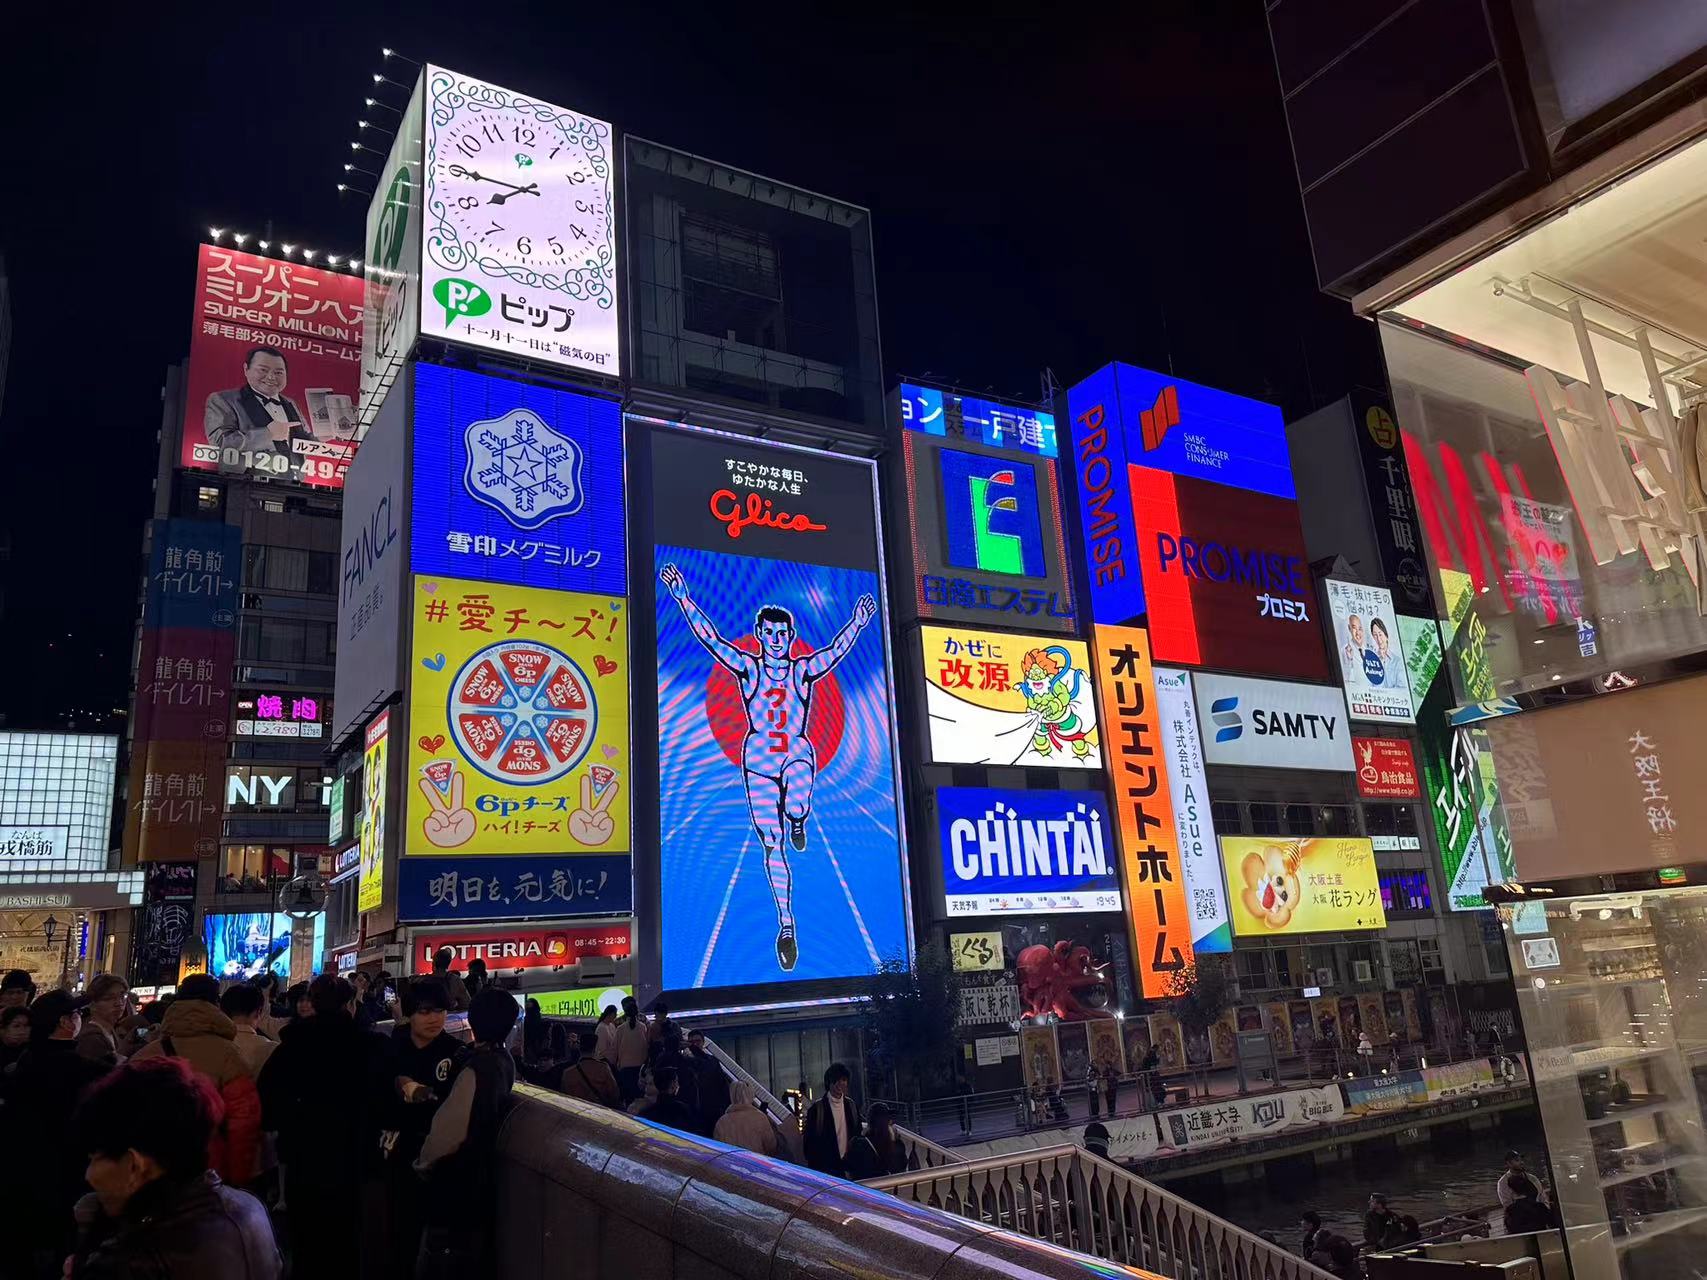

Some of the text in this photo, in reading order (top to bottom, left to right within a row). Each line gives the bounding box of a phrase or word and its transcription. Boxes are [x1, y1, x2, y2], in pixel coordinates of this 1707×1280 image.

[482, 124, 505, 144] 11
[511, 126, 537, 148] 12
[456, 134, 482, 159] 10
[548, 146, 562, 160] 1
[448, 164, 470, 180] 9
[565, 171, 586, 186] 2
[458, 196, 479, 210] 8
[574, 199, 594, 215] 3
[484, 221, 505, 237] 7
[569, 222, 588, 241] 4
[516, 236, 532, 255] 6
[546, 236, 564, 255] 5
[206, 251, 319, 288] スーパー
[204, 301, 272, 324] SUPER
[278, 316, 348, 341] MILLION
[500, 293, 575, 333] ピップ
[1184, 432, 1206, 446] SMBC
[1372, 409, 1395, 445] 占
[1185, 442, 1230, 461] CONSUMER
[1187, 453, 1223, 469] FINANCE
[725, 458, 809, 483] すこやかな毎日、
[732, 473, 801, 495] ゆたかな人生
[1077, 404, 1126, 587] PROMISE
[710, 489, 827, 538] Glico
[342, 485, 397, 608] FANCL
[446, 530, 602, 568] 雪印メグミルク
[165, 547, 225, 572] 龍角散
[1157, 532, 1305, 595] PROMISE
[154, 571, 221, 595] ダイレクト
[1256, 592, 1310, 622] プロミス
[509, 653, 543, 664] SNOW
[944, 637, 1002, 658] かぜに
[155, 657, 214, 681] 龍角散
[464, 665, 489, 697] SNOW
[938, 658, 1011, 692] 改源
[1158, 674, 1180, 687] Asue
[144, 682, 211, 705] ダイレクト
[560, 673, 583, 703] SNOW
[763, 684, 789, 753] グリコ
[1252, 709, 1336, 740] SAMTY
[464, 721, 487, 752] SNOW
[561, 725, 582, 757] SNOW
[506, 760, 541, 771] SNOW
[144, 773, 207, 797] 龍角散
[227, 775, 292, 805] NY
[1173, 720, 1203, 857] 株式会社 Asue
[133, 800, 202, 823] ダイレクト
[1109, 644, 1184, 972] オリエントホーム
[11, 830, 44, 840] なんば
[483, 820, 561, 834] ハイ!チーズ
[1309, 874, 1343, 886] 大阪土産
[952, 901, 978, 911] 天気予報
[1328, 888, 1377, 910] 花ラング
[1187, 1107, 1241, 1131] 近畿大学
